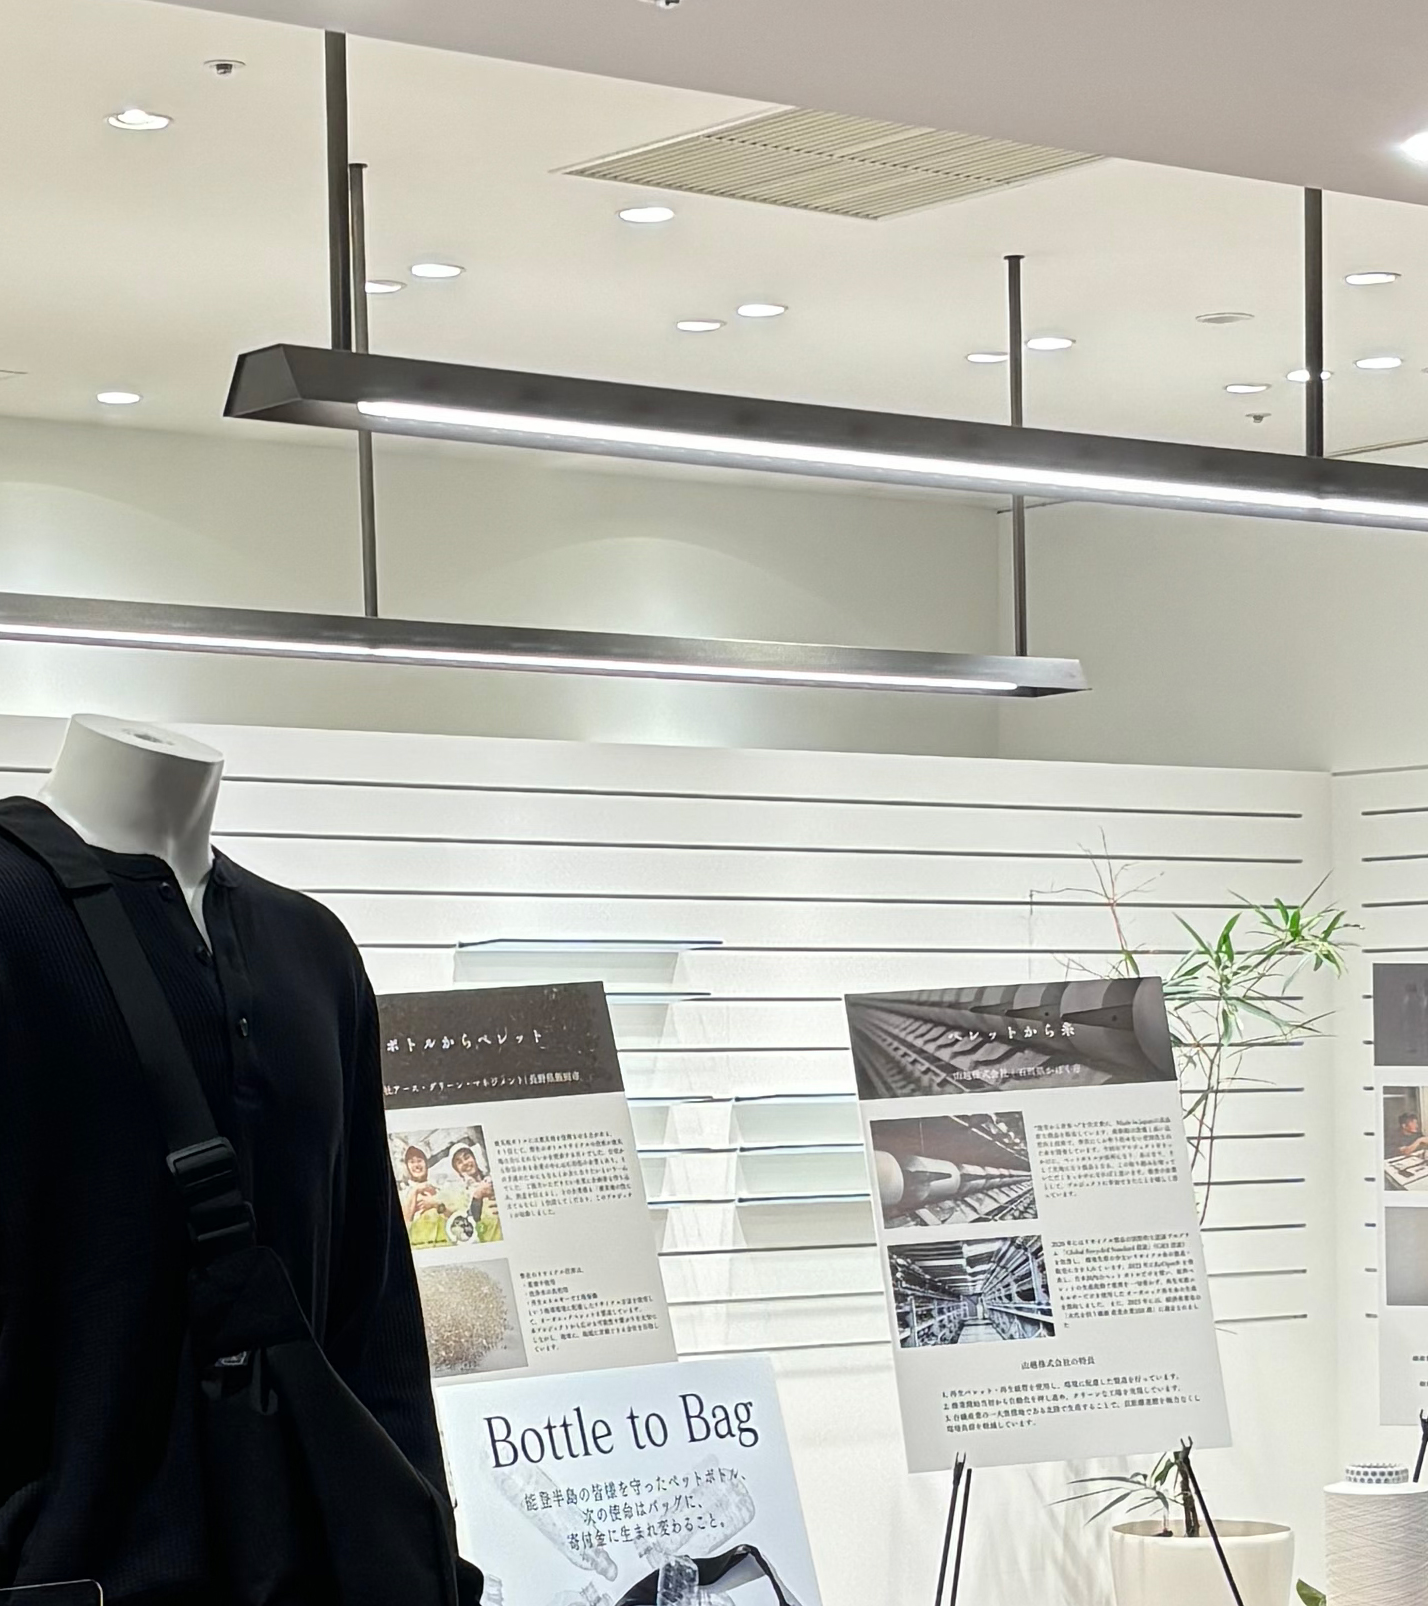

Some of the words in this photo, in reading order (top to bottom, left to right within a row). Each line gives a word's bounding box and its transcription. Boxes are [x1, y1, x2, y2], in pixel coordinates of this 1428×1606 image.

[386, 1027, 542, 1052] ボトルからペレット
[948, 1022, 1075, 1041] ペレットから糸
[483, 1406, 615, 1469] Bottle
[626, 1406, 669, 1450] to
[679, 1392, 759, 1448] Bag
[524, 1467, 746, 1512] 能登半島の皆様を守ったペットボトル、
[583, 1494, 703, 1526] 次の使命はバッグに、
[567, 1512, 725, 1550] 寄付金に生まれ変わること。
